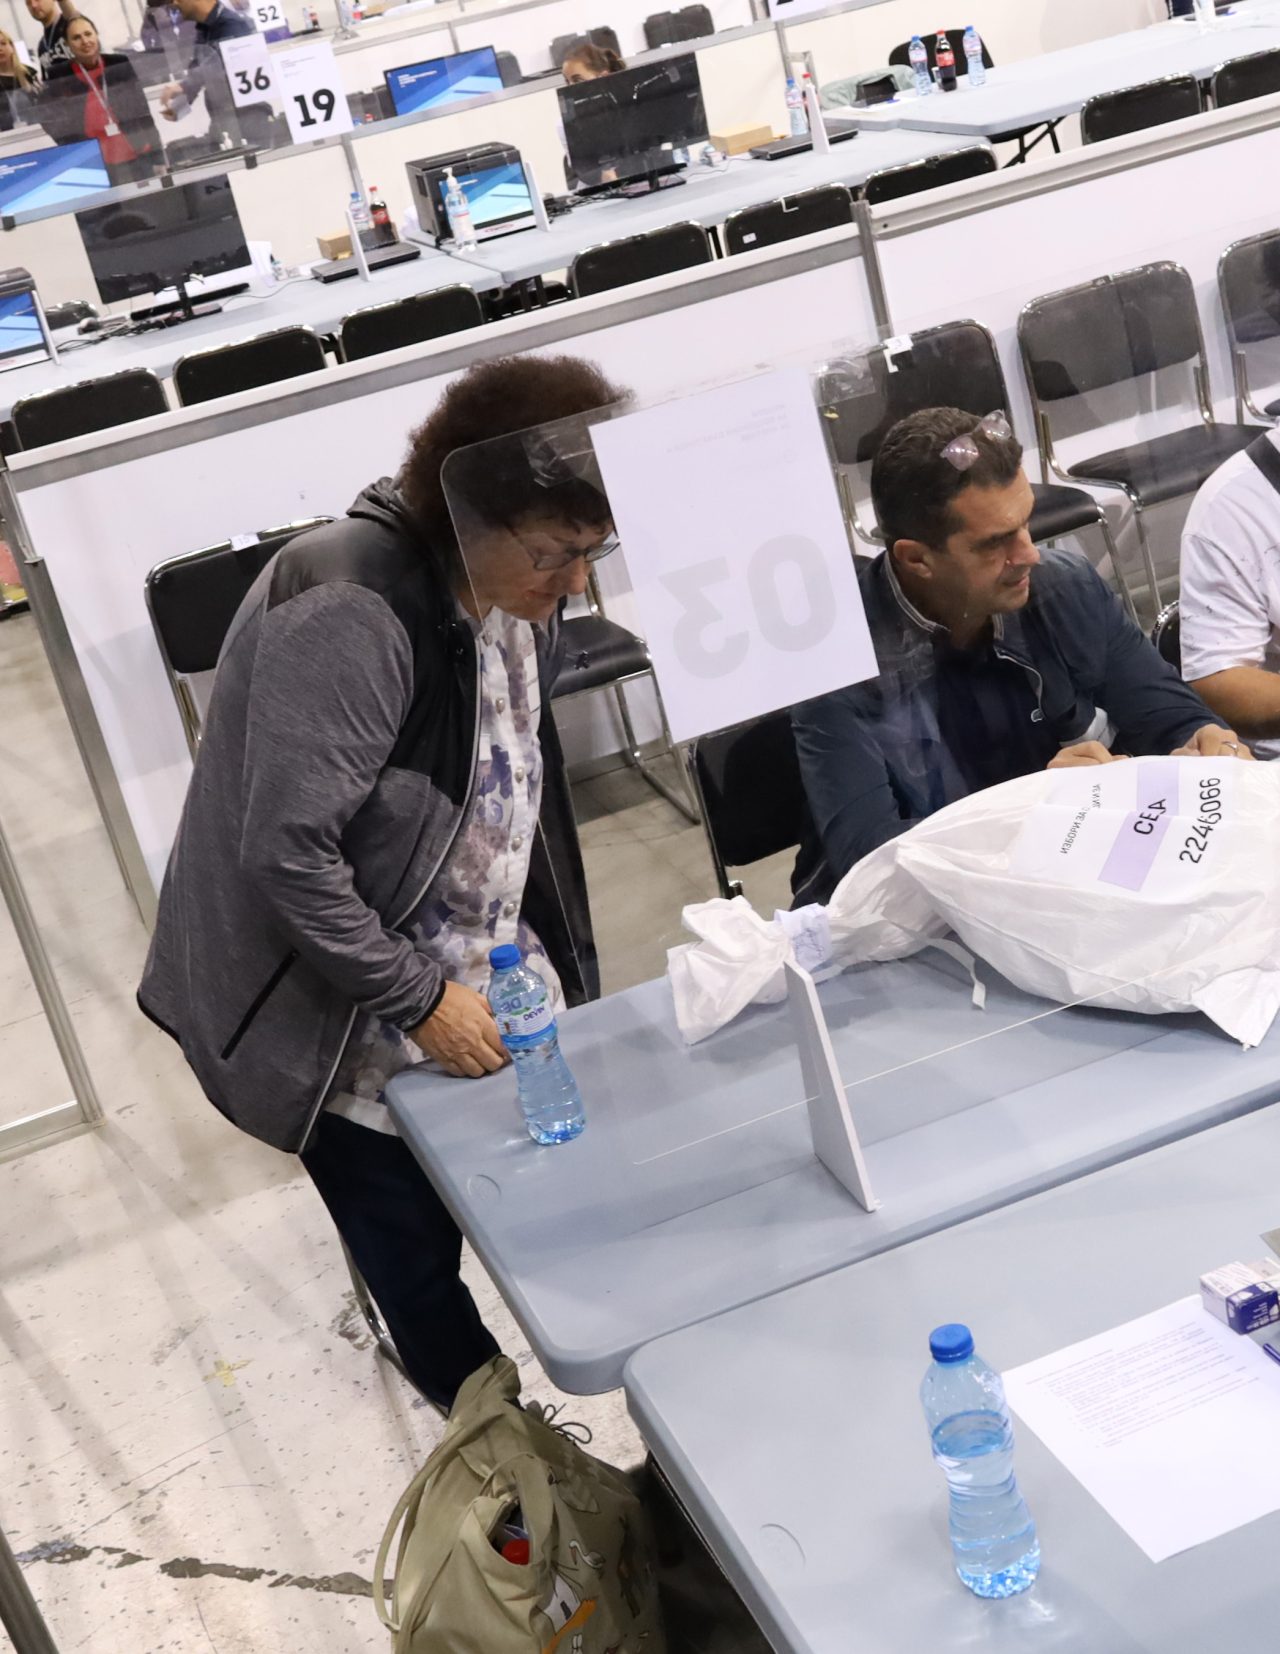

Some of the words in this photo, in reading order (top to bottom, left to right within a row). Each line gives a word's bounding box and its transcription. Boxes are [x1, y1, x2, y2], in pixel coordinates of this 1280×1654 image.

[257, 5, 280, 23] 52
[234, 67, 270, 95] 36
[293, 89, 335, 128] 19
[1060, 821, 1081, 854] ИЗБОРИ
[523, 1004, 545, 1021] DEVIN
